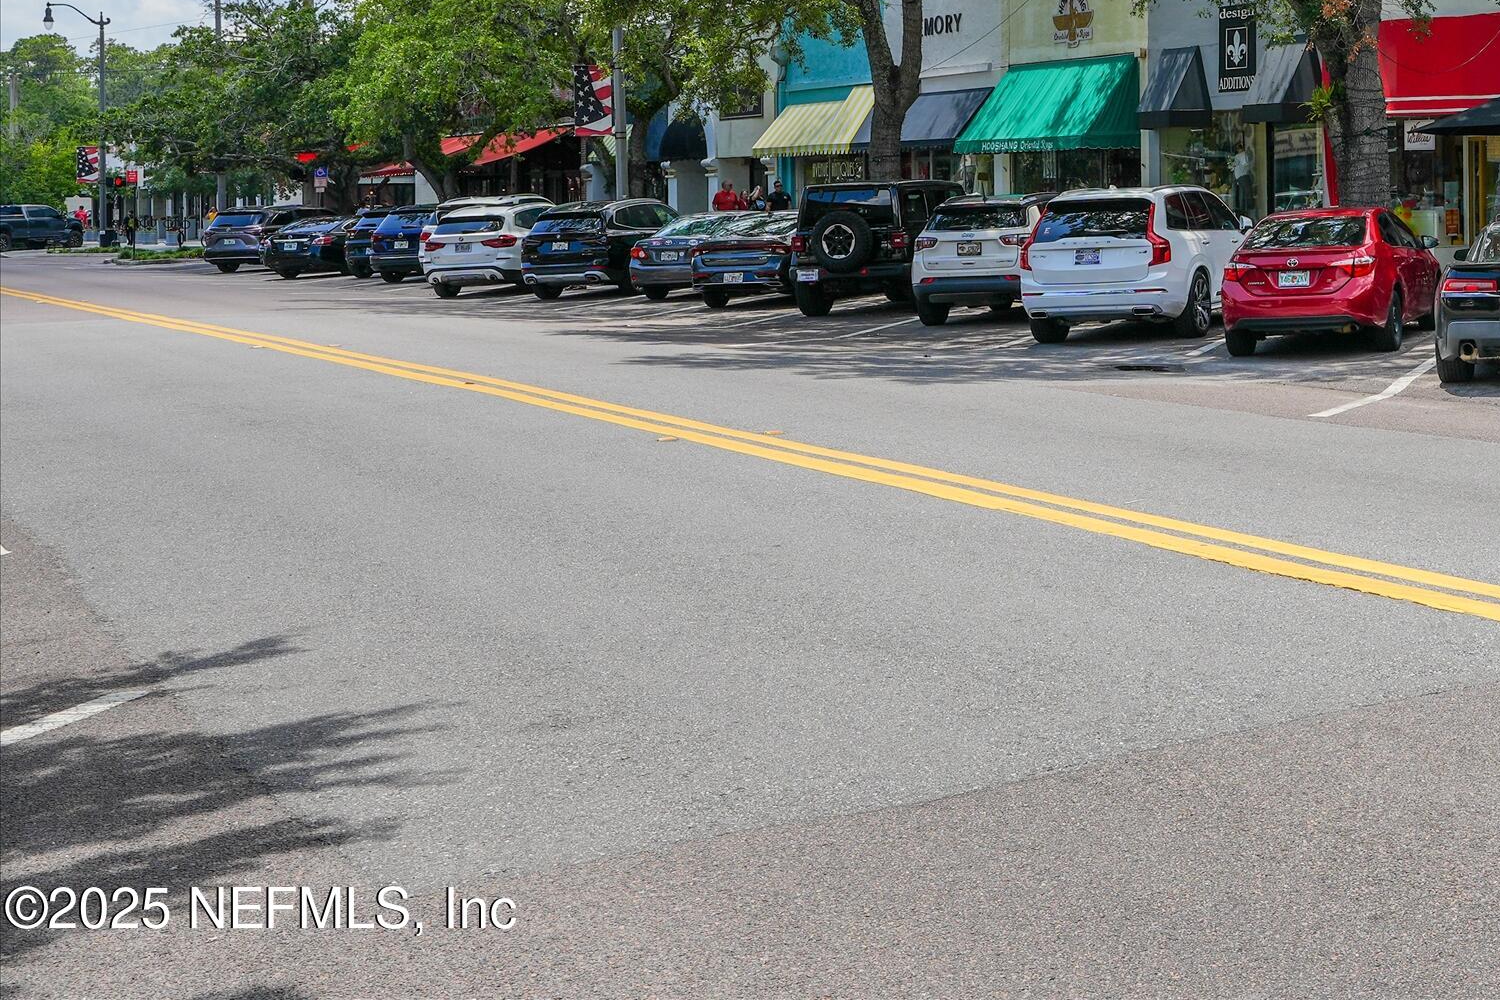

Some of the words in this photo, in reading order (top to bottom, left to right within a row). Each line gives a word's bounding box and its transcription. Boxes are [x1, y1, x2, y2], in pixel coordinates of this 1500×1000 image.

[1219, 8, 1255, 20] design
[921, 13, 962, 36] MORY
[1219, 75, 1255, 90] ADDITIONS
